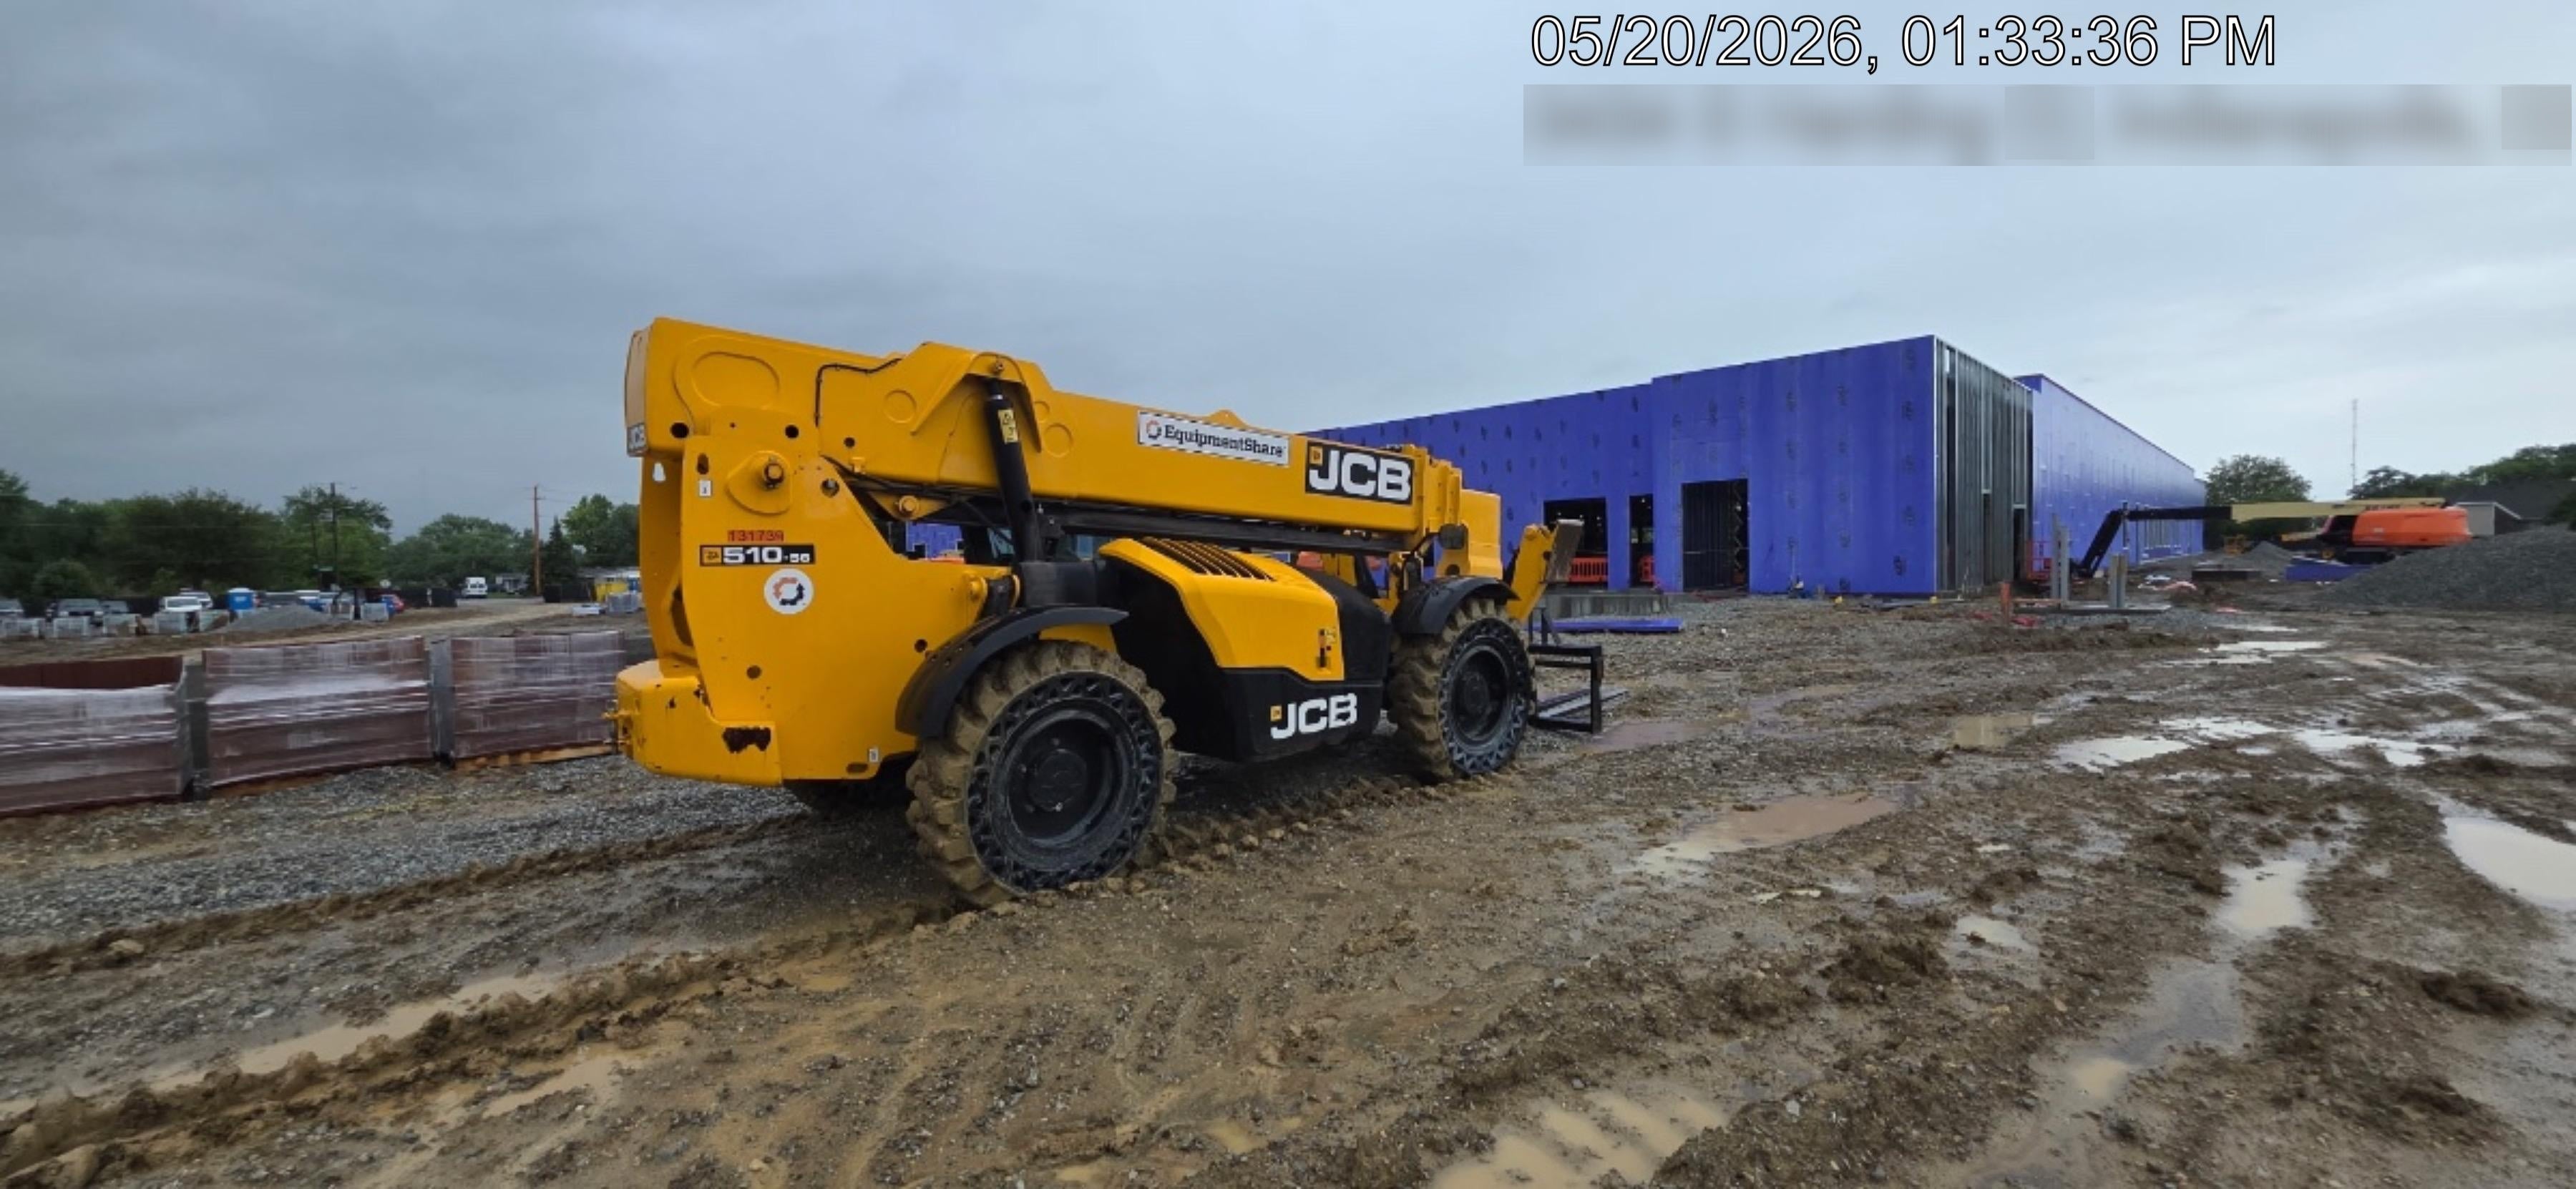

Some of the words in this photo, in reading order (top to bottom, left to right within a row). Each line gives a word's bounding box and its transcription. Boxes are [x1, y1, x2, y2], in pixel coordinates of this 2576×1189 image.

[1164, 424, 1284, 457] EquipmentShare
[1309, 449, 1411, 501] JCB
[1270, 693, 1357, 739] JCB
